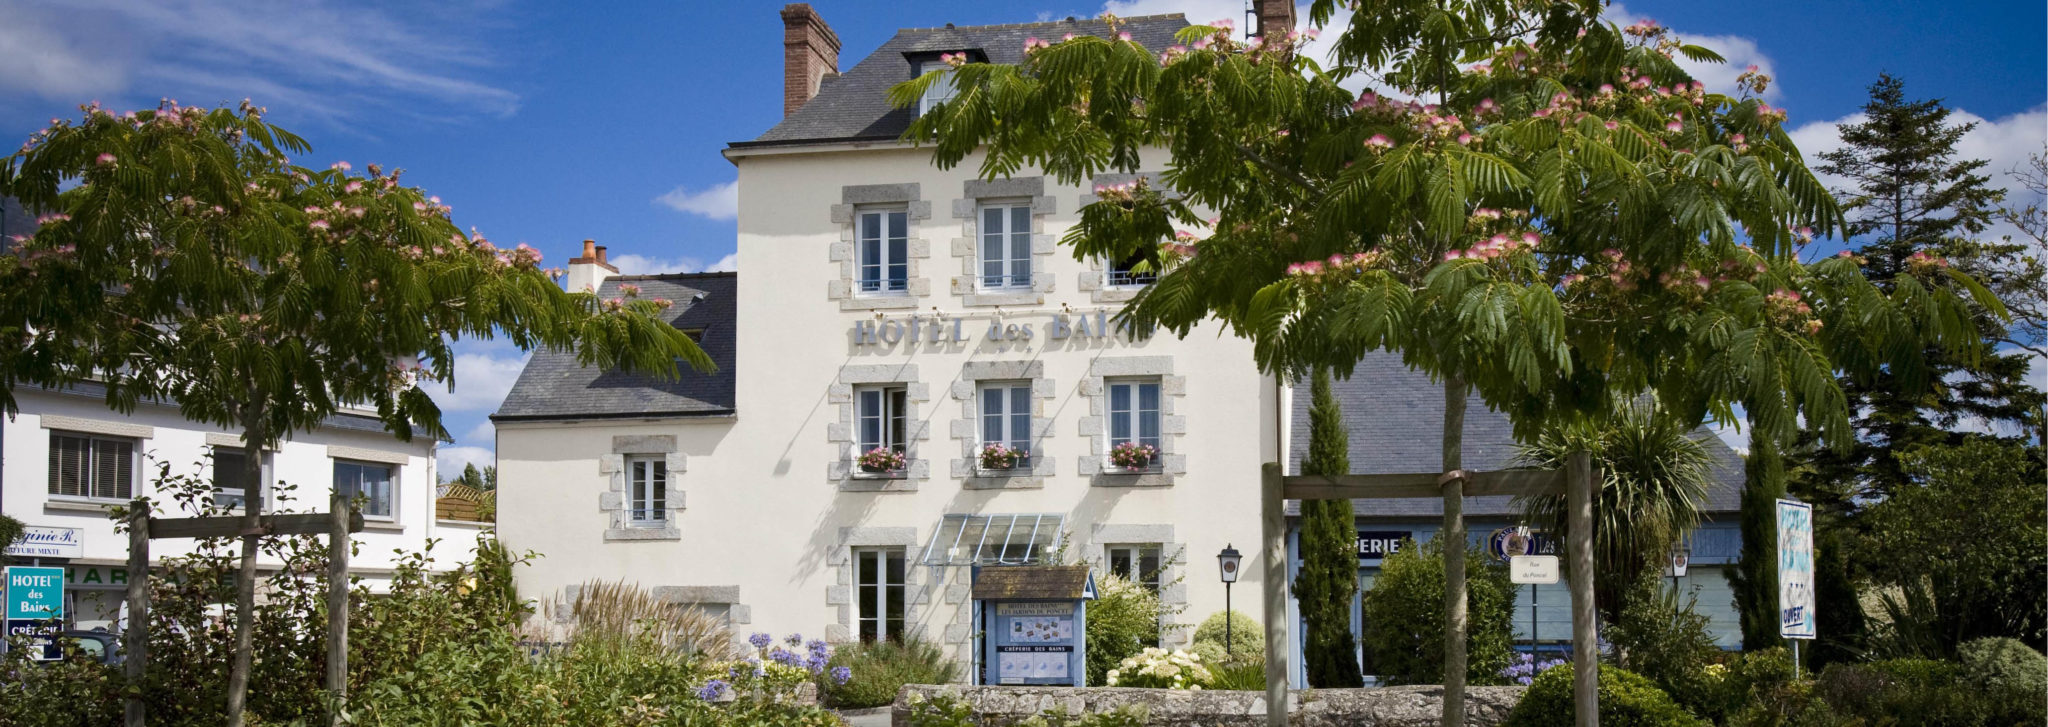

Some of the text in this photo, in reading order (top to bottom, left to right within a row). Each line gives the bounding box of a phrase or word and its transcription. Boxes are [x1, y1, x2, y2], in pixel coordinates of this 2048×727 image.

[855, 318, 969, 344] HOTEL
[988, 317, 1034, 341] des
[1783, 606, 1804, 624] OUVERT
